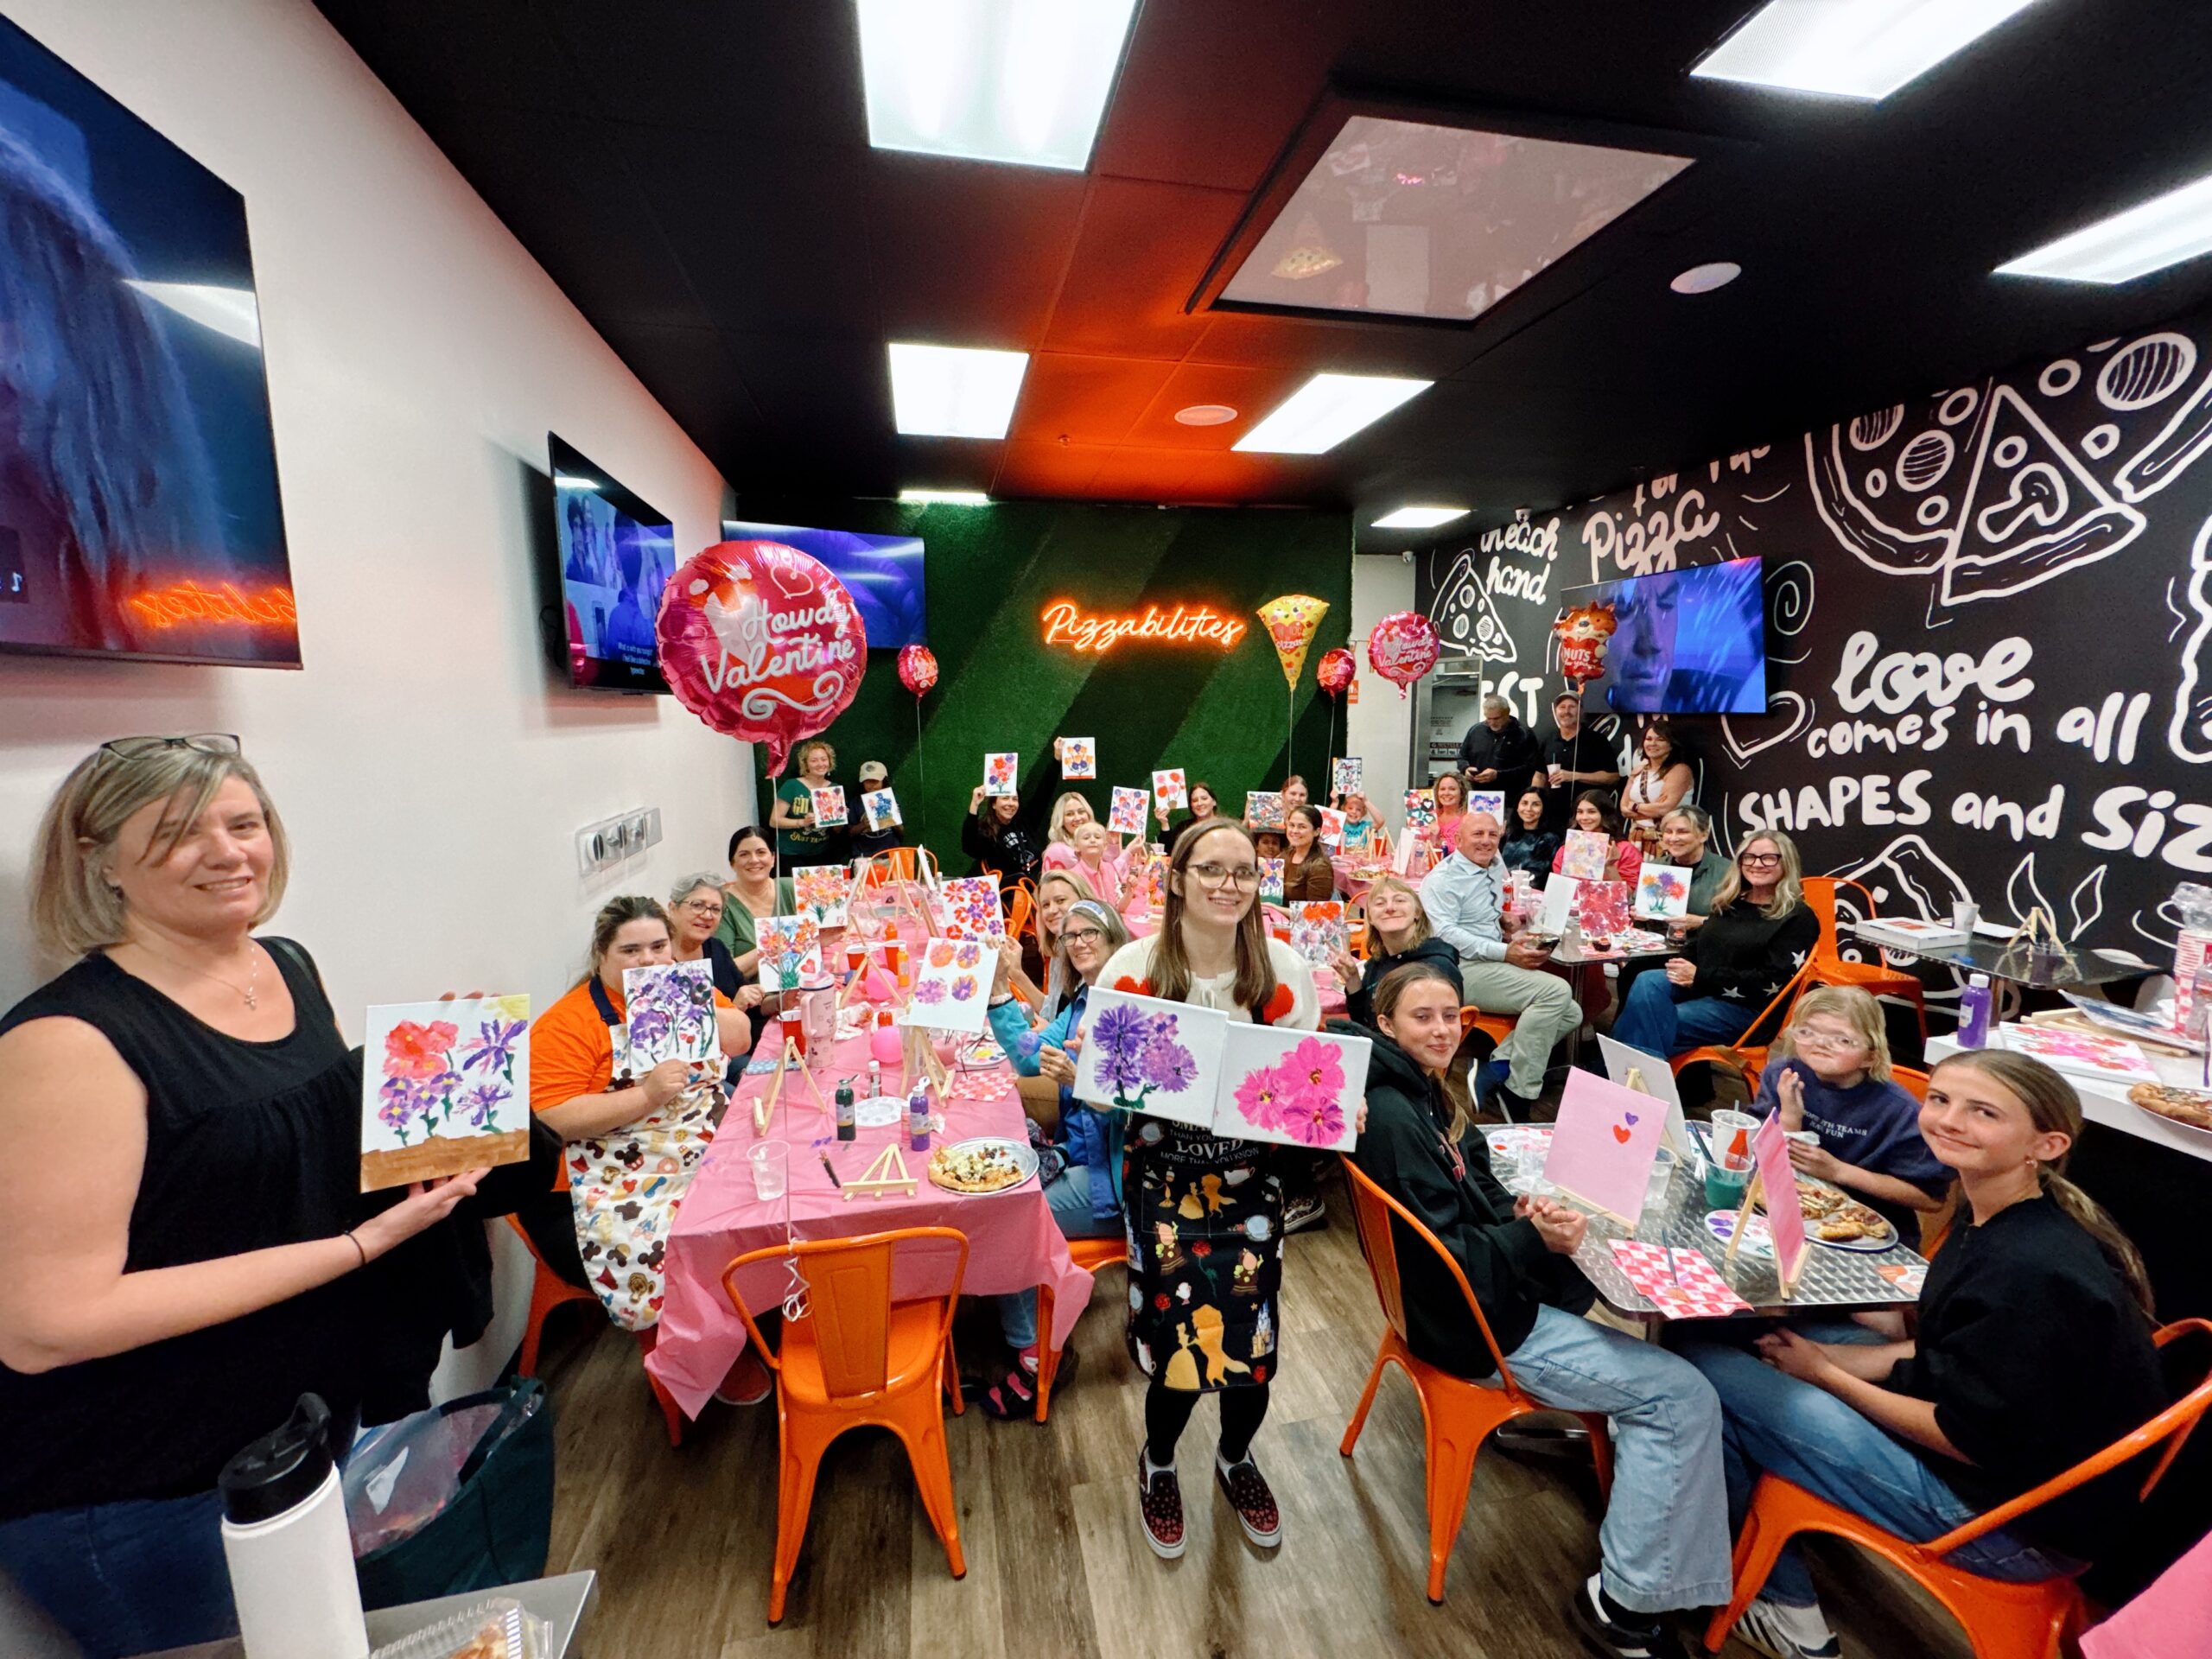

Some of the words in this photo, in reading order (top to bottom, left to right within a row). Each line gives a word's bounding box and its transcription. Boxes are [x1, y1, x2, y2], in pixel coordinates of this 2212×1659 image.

[1504, 517, 1560, 561] each
[1582, 489, 1720, 583] Pizza
[1485, 556, 1550, 605] hand
[741, 588, 852, 643] Howdy
[1043, 603, 1244, 651] Pizzabilities
[701, 632, 856, 693] Valentine
[1565, 648, 1591, 662] NUTS
[1832, 631, 2035, 715] love
[1807, 706, 1956, 759] comes
[1976, 701, 2031, 753] in
[2056, 691, 2151, 765] all
[1738, 769, 1933, 838] SHAPES
[1951, 784, 2065, 842] and
[1176, 1138, 1244, 1159] LOVED
[1234, 1147, 1260, 1160] KNOW
[1825, 1128, 1845, 1139] FUN
